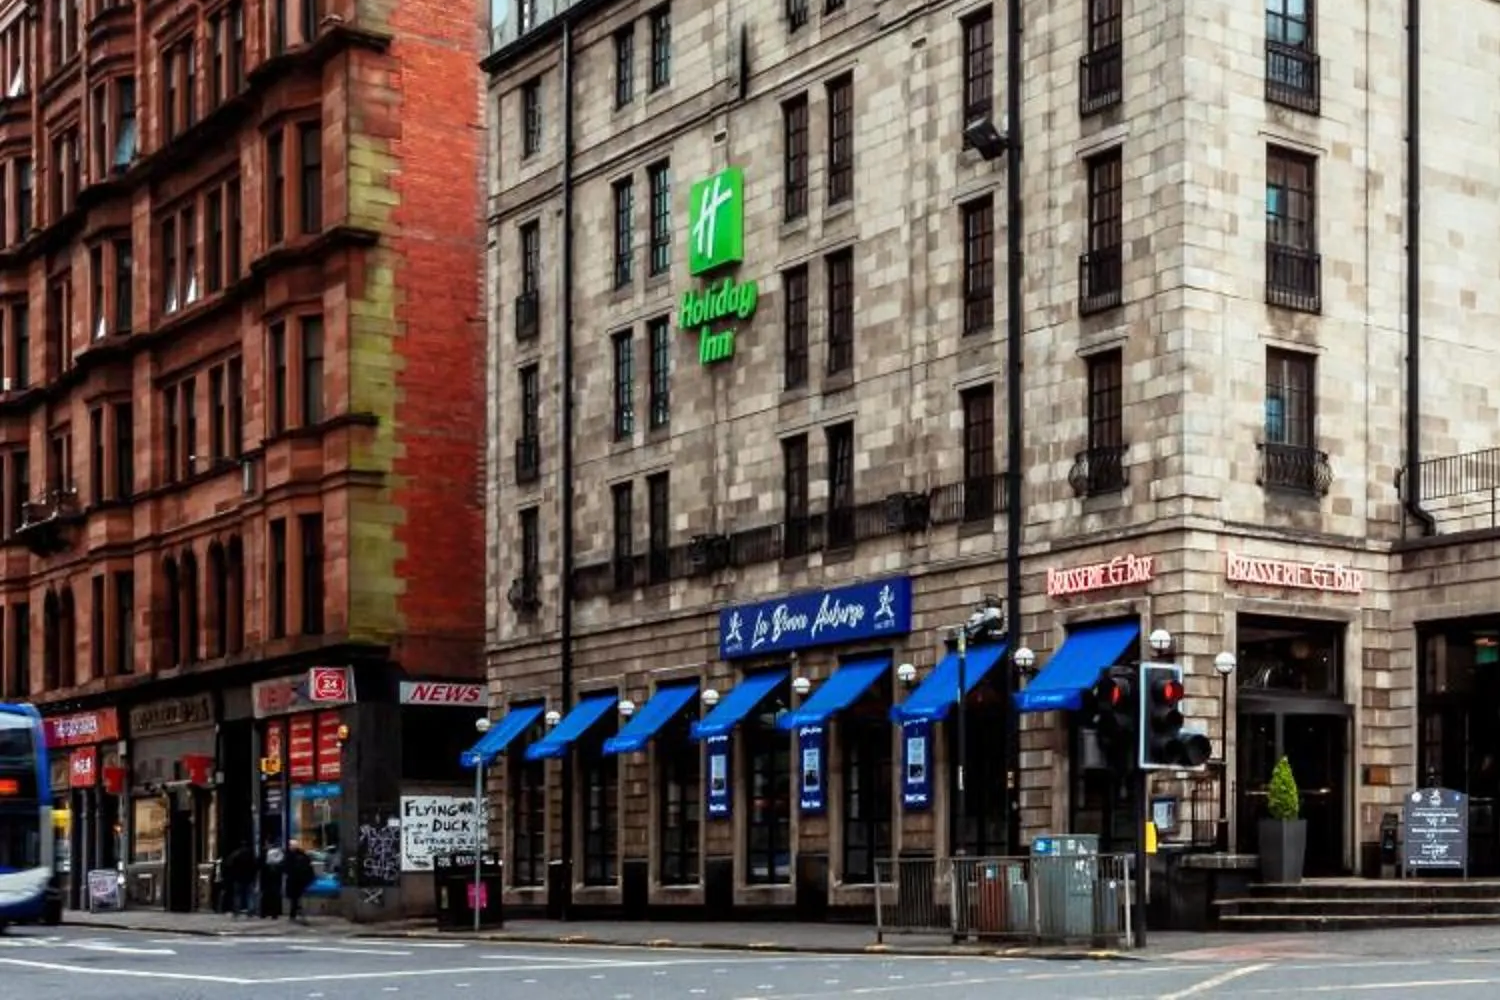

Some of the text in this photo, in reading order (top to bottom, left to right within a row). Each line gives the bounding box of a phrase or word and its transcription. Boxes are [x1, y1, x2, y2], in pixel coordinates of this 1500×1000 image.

[679, 277, 758, 329] Holiday
[699, 324, 735, 365] Inn
[752, 593, 865, 649] La Bonne Auberge
[411, 683, 481, 703] NEWS
[432, 818, 471, 833] DUCK
